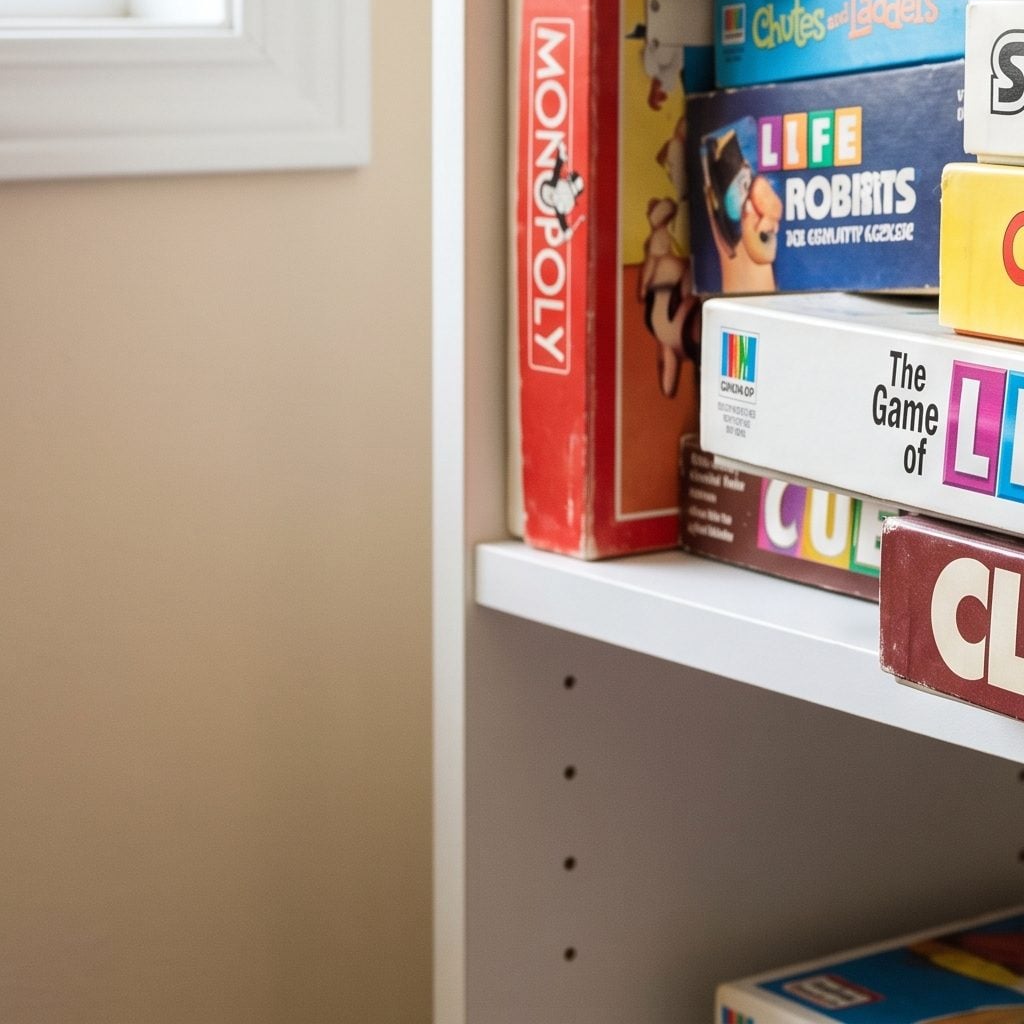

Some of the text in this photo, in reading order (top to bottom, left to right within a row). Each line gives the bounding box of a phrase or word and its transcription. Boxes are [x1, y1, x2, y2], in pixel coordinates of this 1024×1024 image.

[827, 2, 849, 30] and
[761, 113, 859, 168] LIFE
[533, 26, 569, 363] MONOPOLY
[889, 350, 926, 391] The
[872, 384, 939, 435] Game
[904, 438, 927, 475] of
